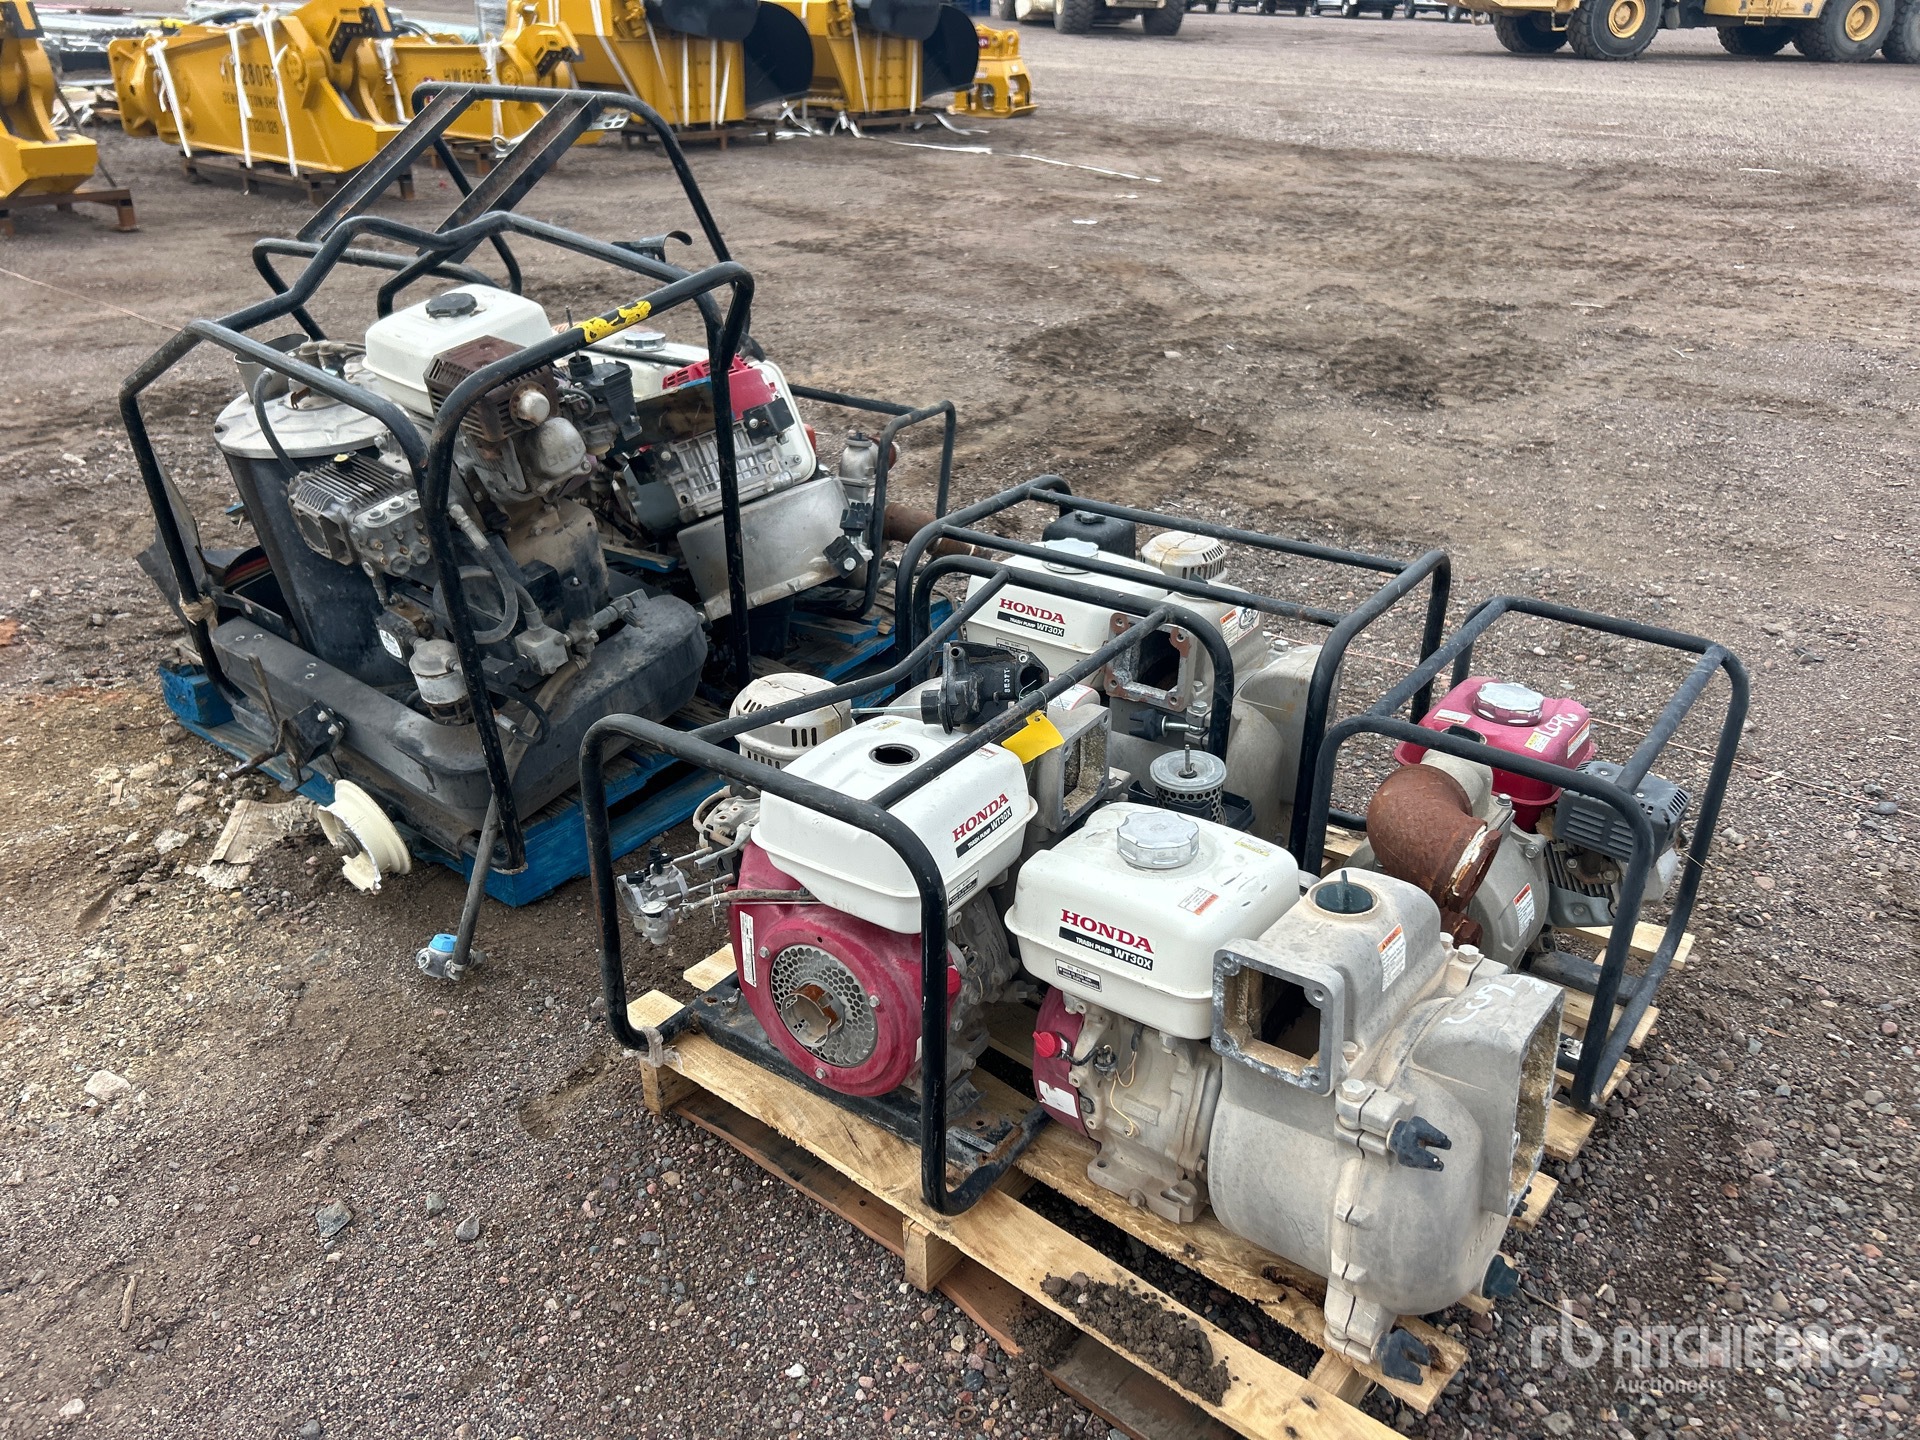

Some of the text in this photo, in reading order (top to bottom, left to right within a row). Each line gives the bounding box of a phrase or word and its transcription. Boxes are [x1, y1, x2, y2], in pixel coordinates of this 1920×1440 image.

[999, 597, 1066, 625] HONDA
[1036, 622, 1064, 637] WT30X
[952, 793, 1009, 843] HONDA
[990, 807, 1012, 833] WT30X
[1060, 908, 1155, 955] HONDA
[1075, 936, 1152, 970] TRASH PUMP WT30X
